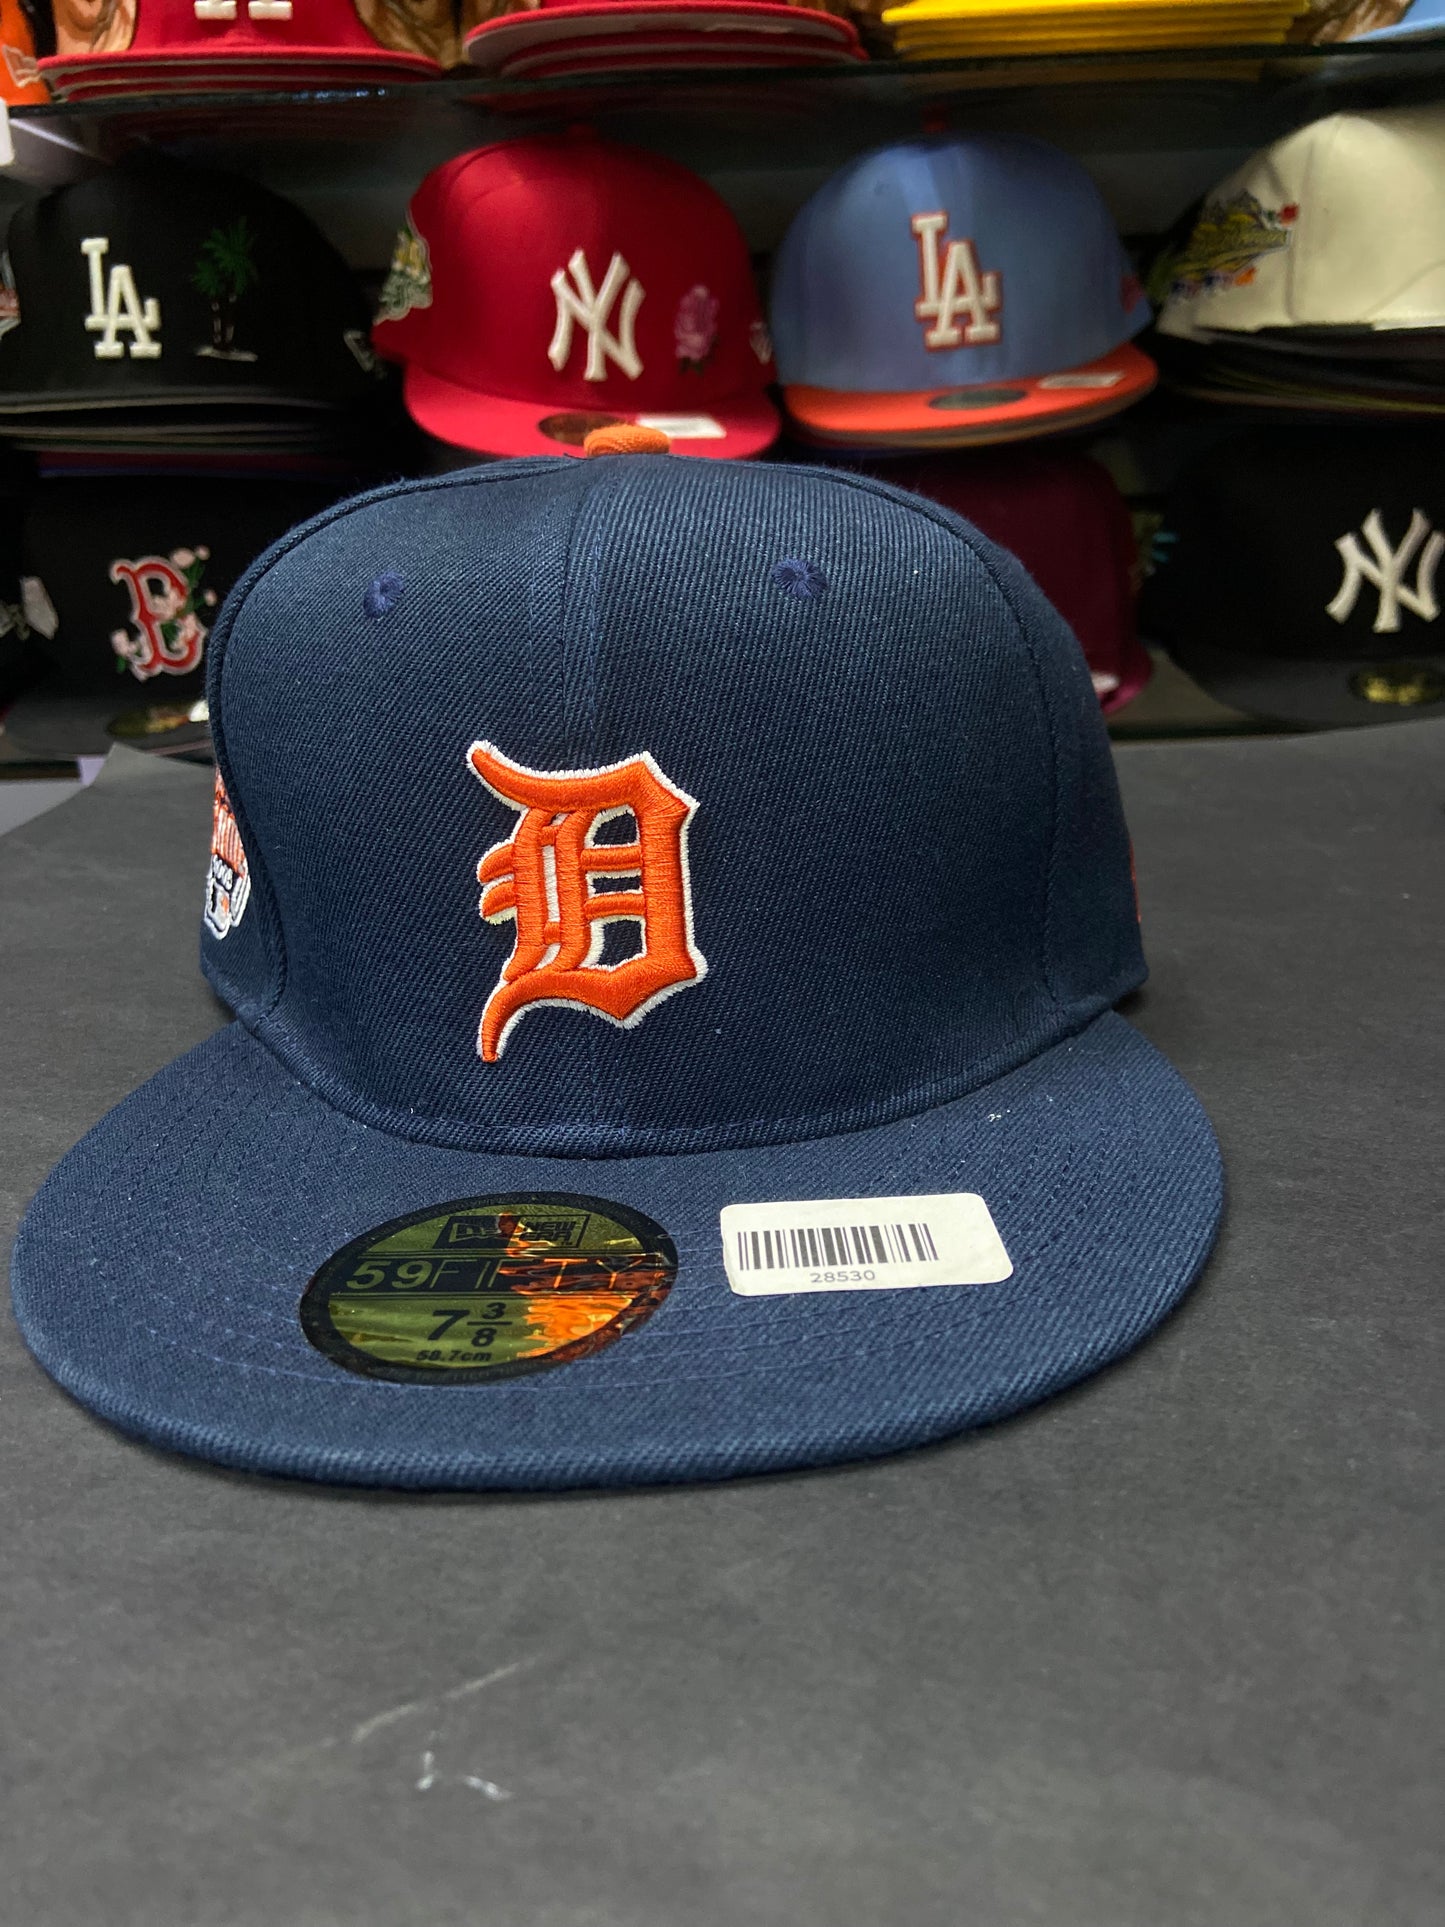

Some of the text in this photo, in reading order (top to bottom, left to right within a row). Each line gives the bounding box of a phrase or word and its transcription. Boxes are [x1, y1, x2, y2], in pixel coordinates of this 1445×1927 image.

[80, 237, 162, 359] LA
[547, 247, 647, 382] NY
[911, 211, 1003, 352] LA
[1325, 507, 1445, 634] NY
[466, 739, 709, 1064] D
[427, 1309, 470, 1341] 7
[809, 1269, 876, 1284] 28530
